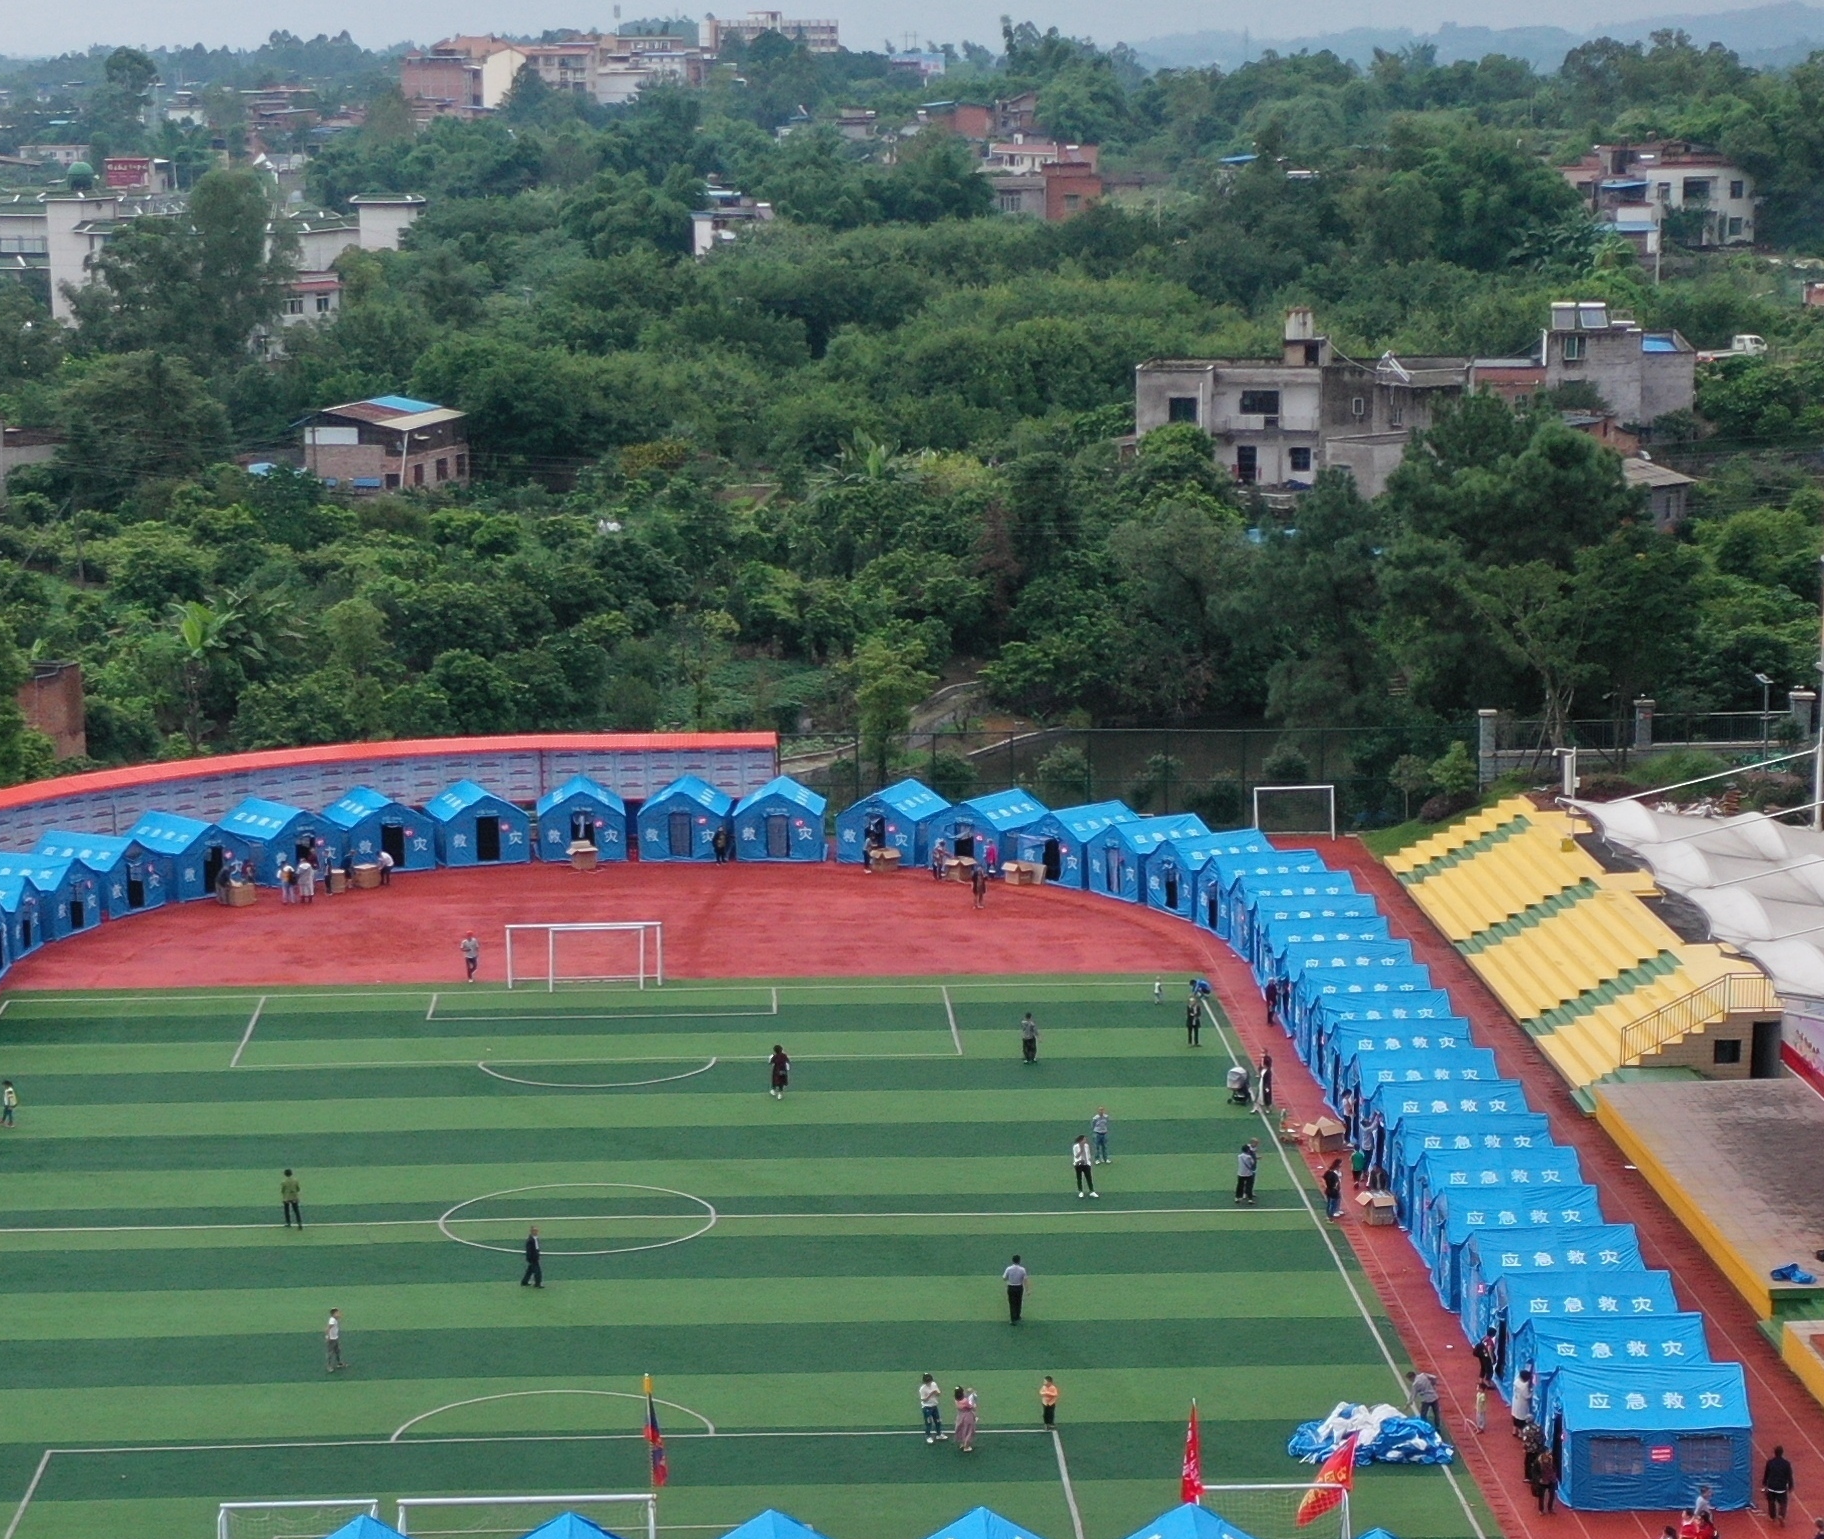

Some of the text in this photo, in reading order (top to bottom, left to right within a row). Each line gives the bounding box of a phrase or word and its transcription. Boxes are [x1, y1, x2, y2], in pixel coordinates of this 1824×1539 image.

[1358, 1036, 1456, 1050] 应急救灾
[1378, 1068, 1478, 1081] 应急救灾
[1403, 1100, 1507, 1114] 应急救灾
[1425, 1136, 1532, 1149] 应急救灾
[1450, 1170, 1561, 1185] 应急救灾
[1467, 1209, 1581, 1225] 应急救灾
[1502, 1249, 1620, 1267] 应急救灾
[1530, 1297, 1653, 1313] 应急救灾
[1557, 1341, 1684, 1358] 应急救灾
[1589, 1392, 1722, 1409] 应急救灾
